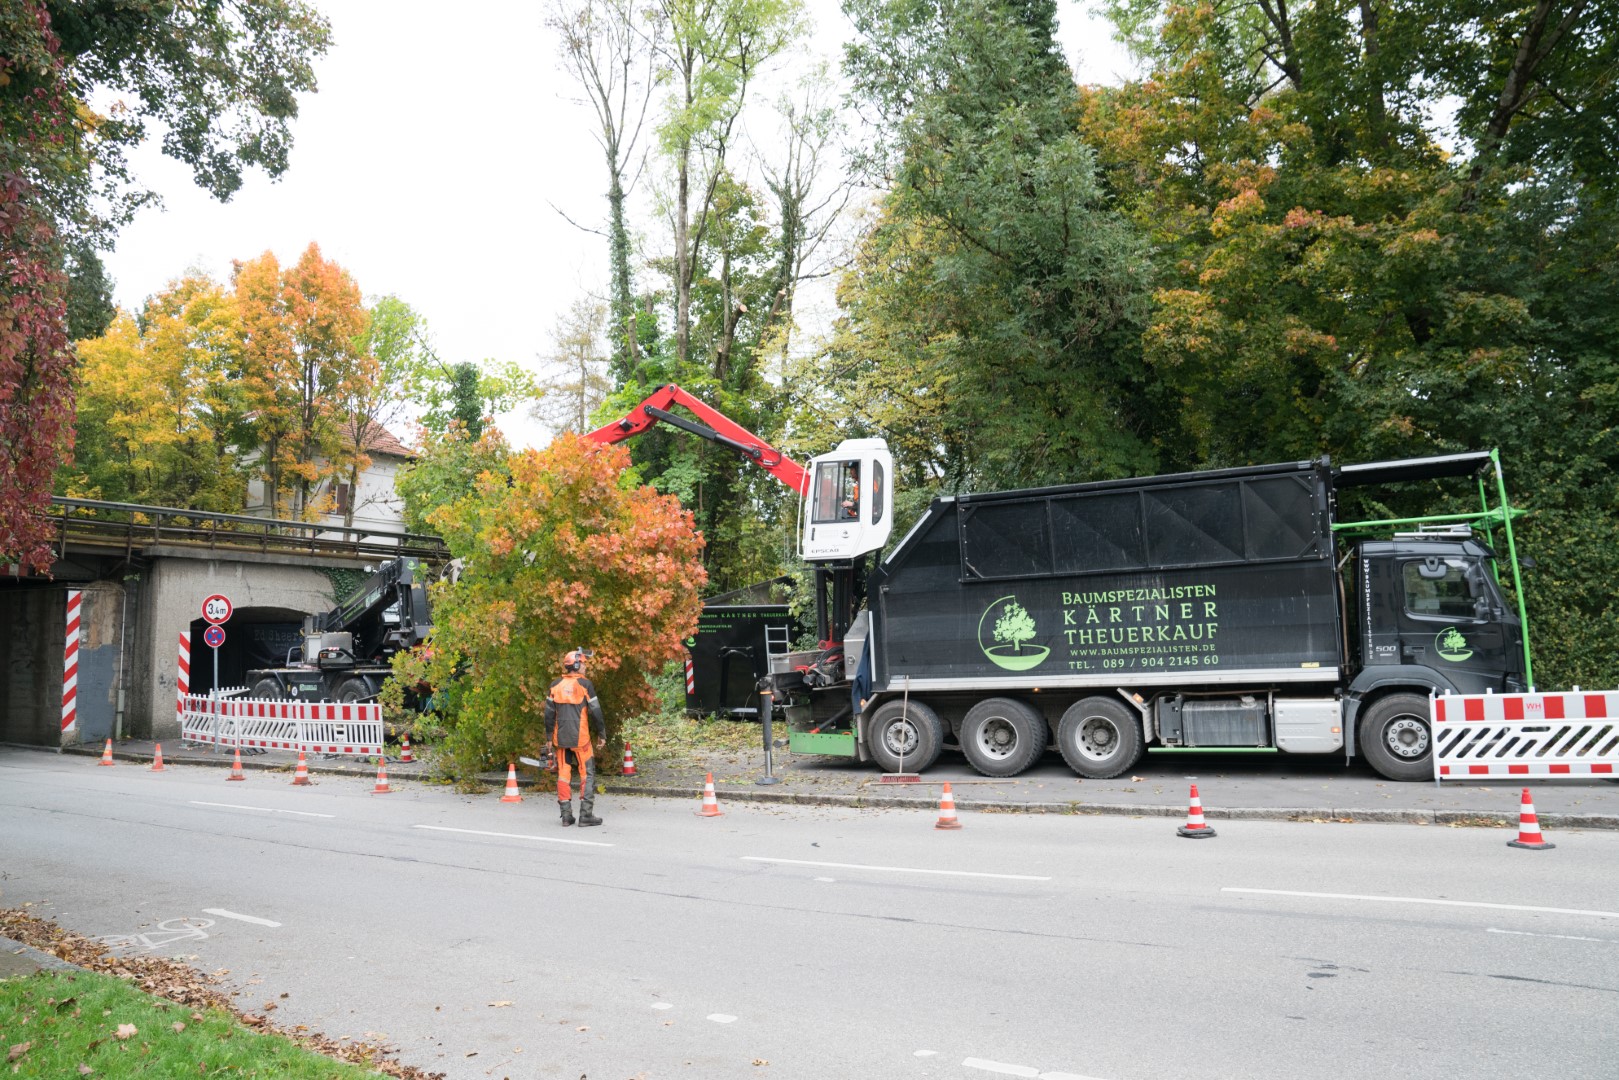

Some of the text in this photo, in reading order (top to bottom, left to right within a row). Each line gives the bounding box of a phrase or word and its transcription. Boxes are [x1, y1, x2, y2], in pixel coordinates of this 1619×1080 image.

[1062, 585, 1216, 605] BAUMSPEZIALISTEN
[1063, 602, 1218, 625] KÄRTNER
[254, 629, 265, 641] Ed
[1064, 623, 1218, 645] THEUERKAUF
[1069, 660, 1095, 670] TEL.
[1103, 658, 1125, 668] 089
[1141, 657, 1164, 667] 904
[1169, 655, 1198, 666] 2145
[1204, 654, 1219, 665] 60
